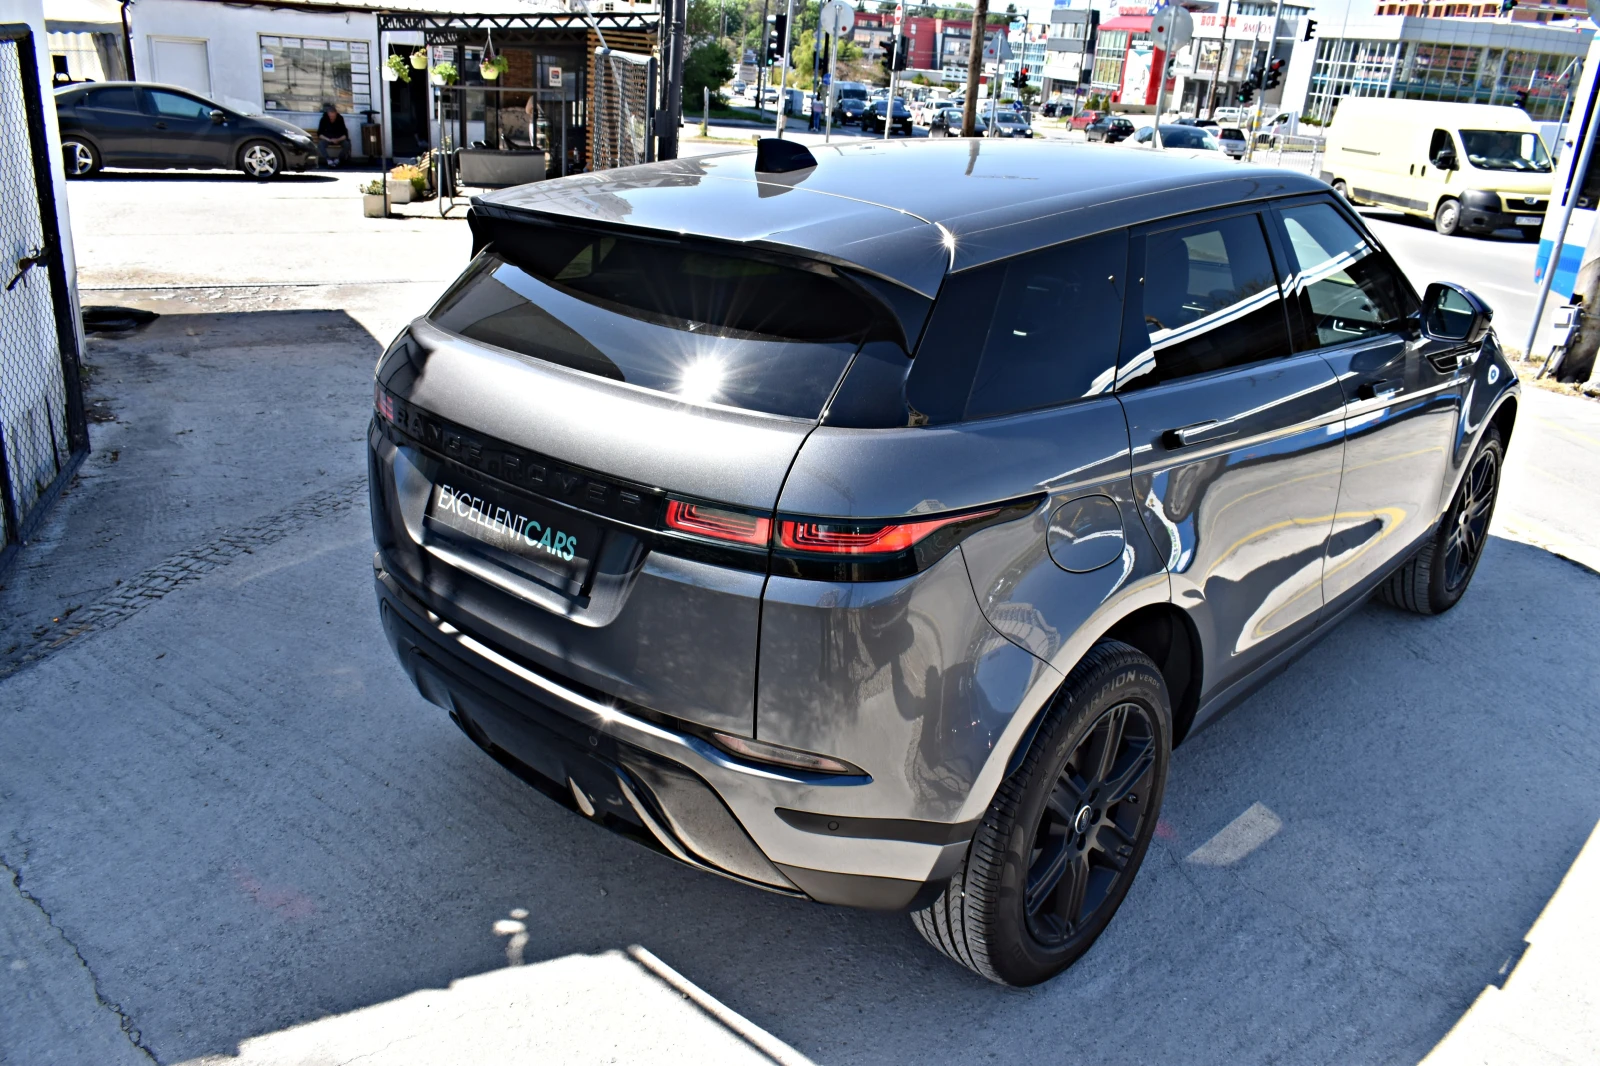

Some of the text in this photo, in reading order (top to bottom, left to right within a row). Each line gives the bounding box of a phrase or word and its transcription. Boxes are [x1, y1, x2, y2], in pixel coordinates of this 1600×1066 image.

[396, 406, 643, 512] RANGE ROVER
[1056, 669, 1161, 758] SCORPION VERDE
